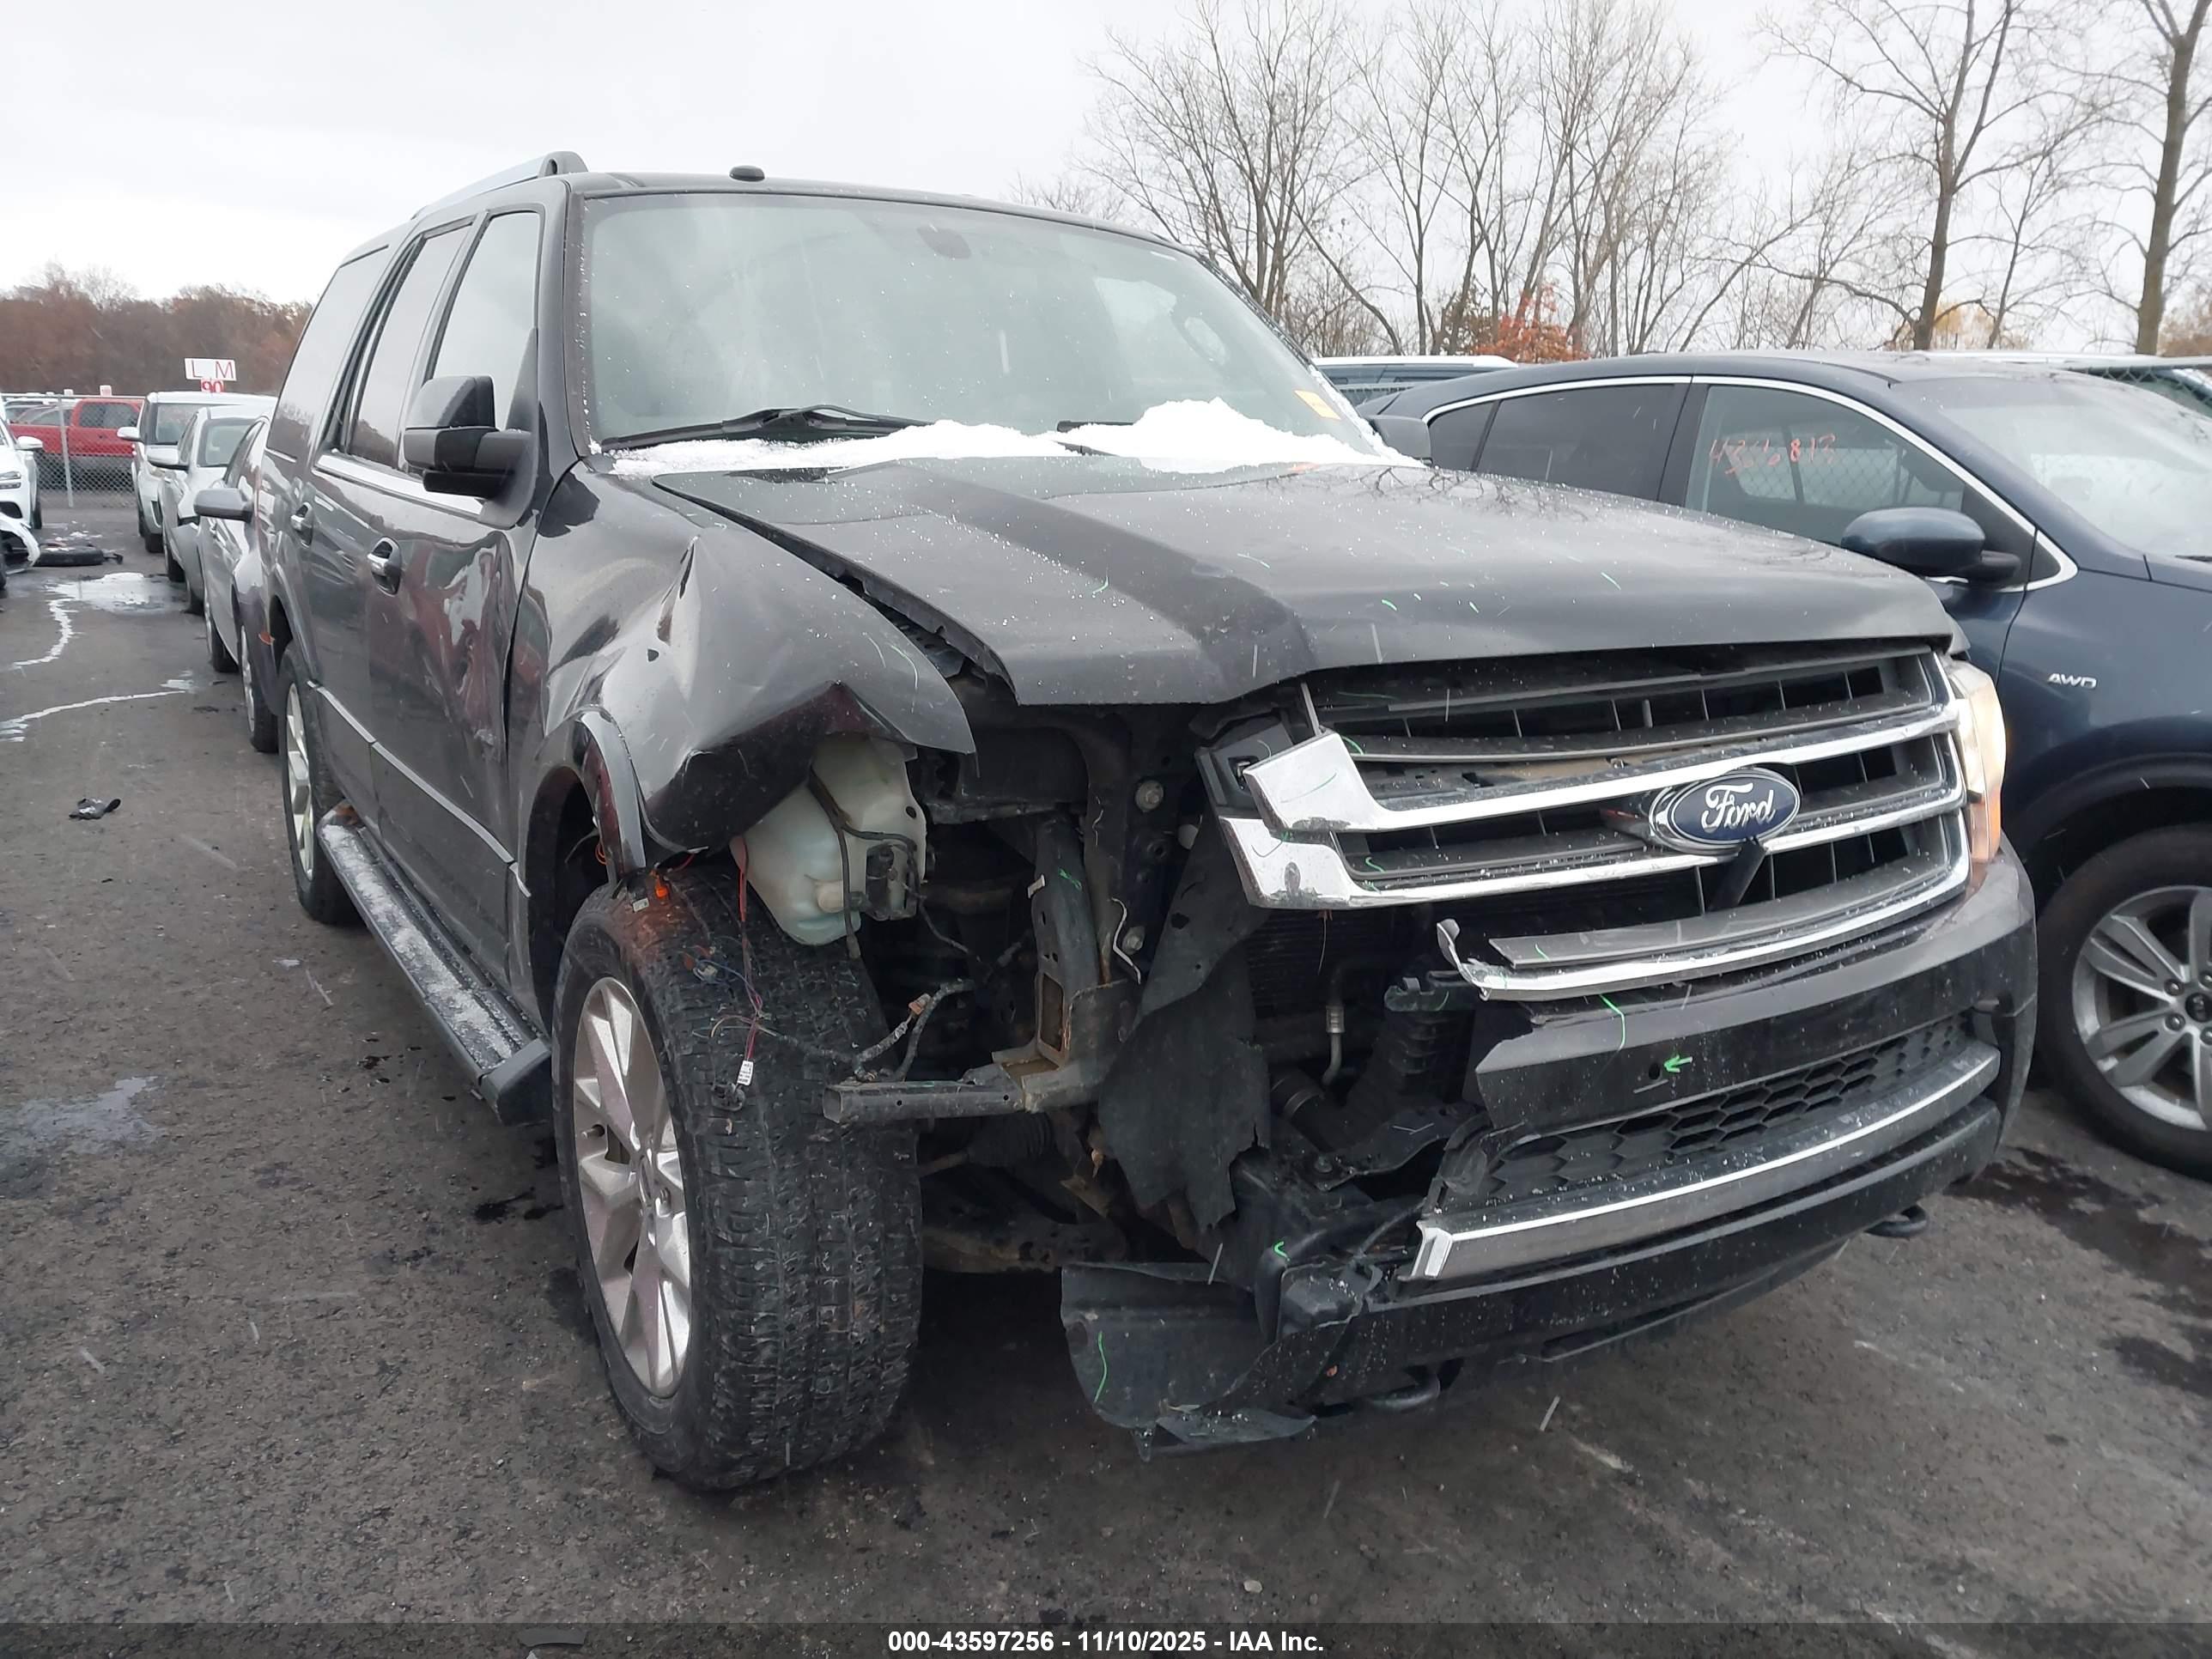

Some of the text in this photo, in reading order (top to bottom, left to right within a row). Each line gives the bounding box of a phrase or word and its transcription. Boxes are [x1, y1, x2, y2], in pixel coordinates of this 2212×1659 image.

[215, 361, 234, 380] M
[2047, 672, 2097, 690] AWD
[1701, 782, 1776, 834] Ford
